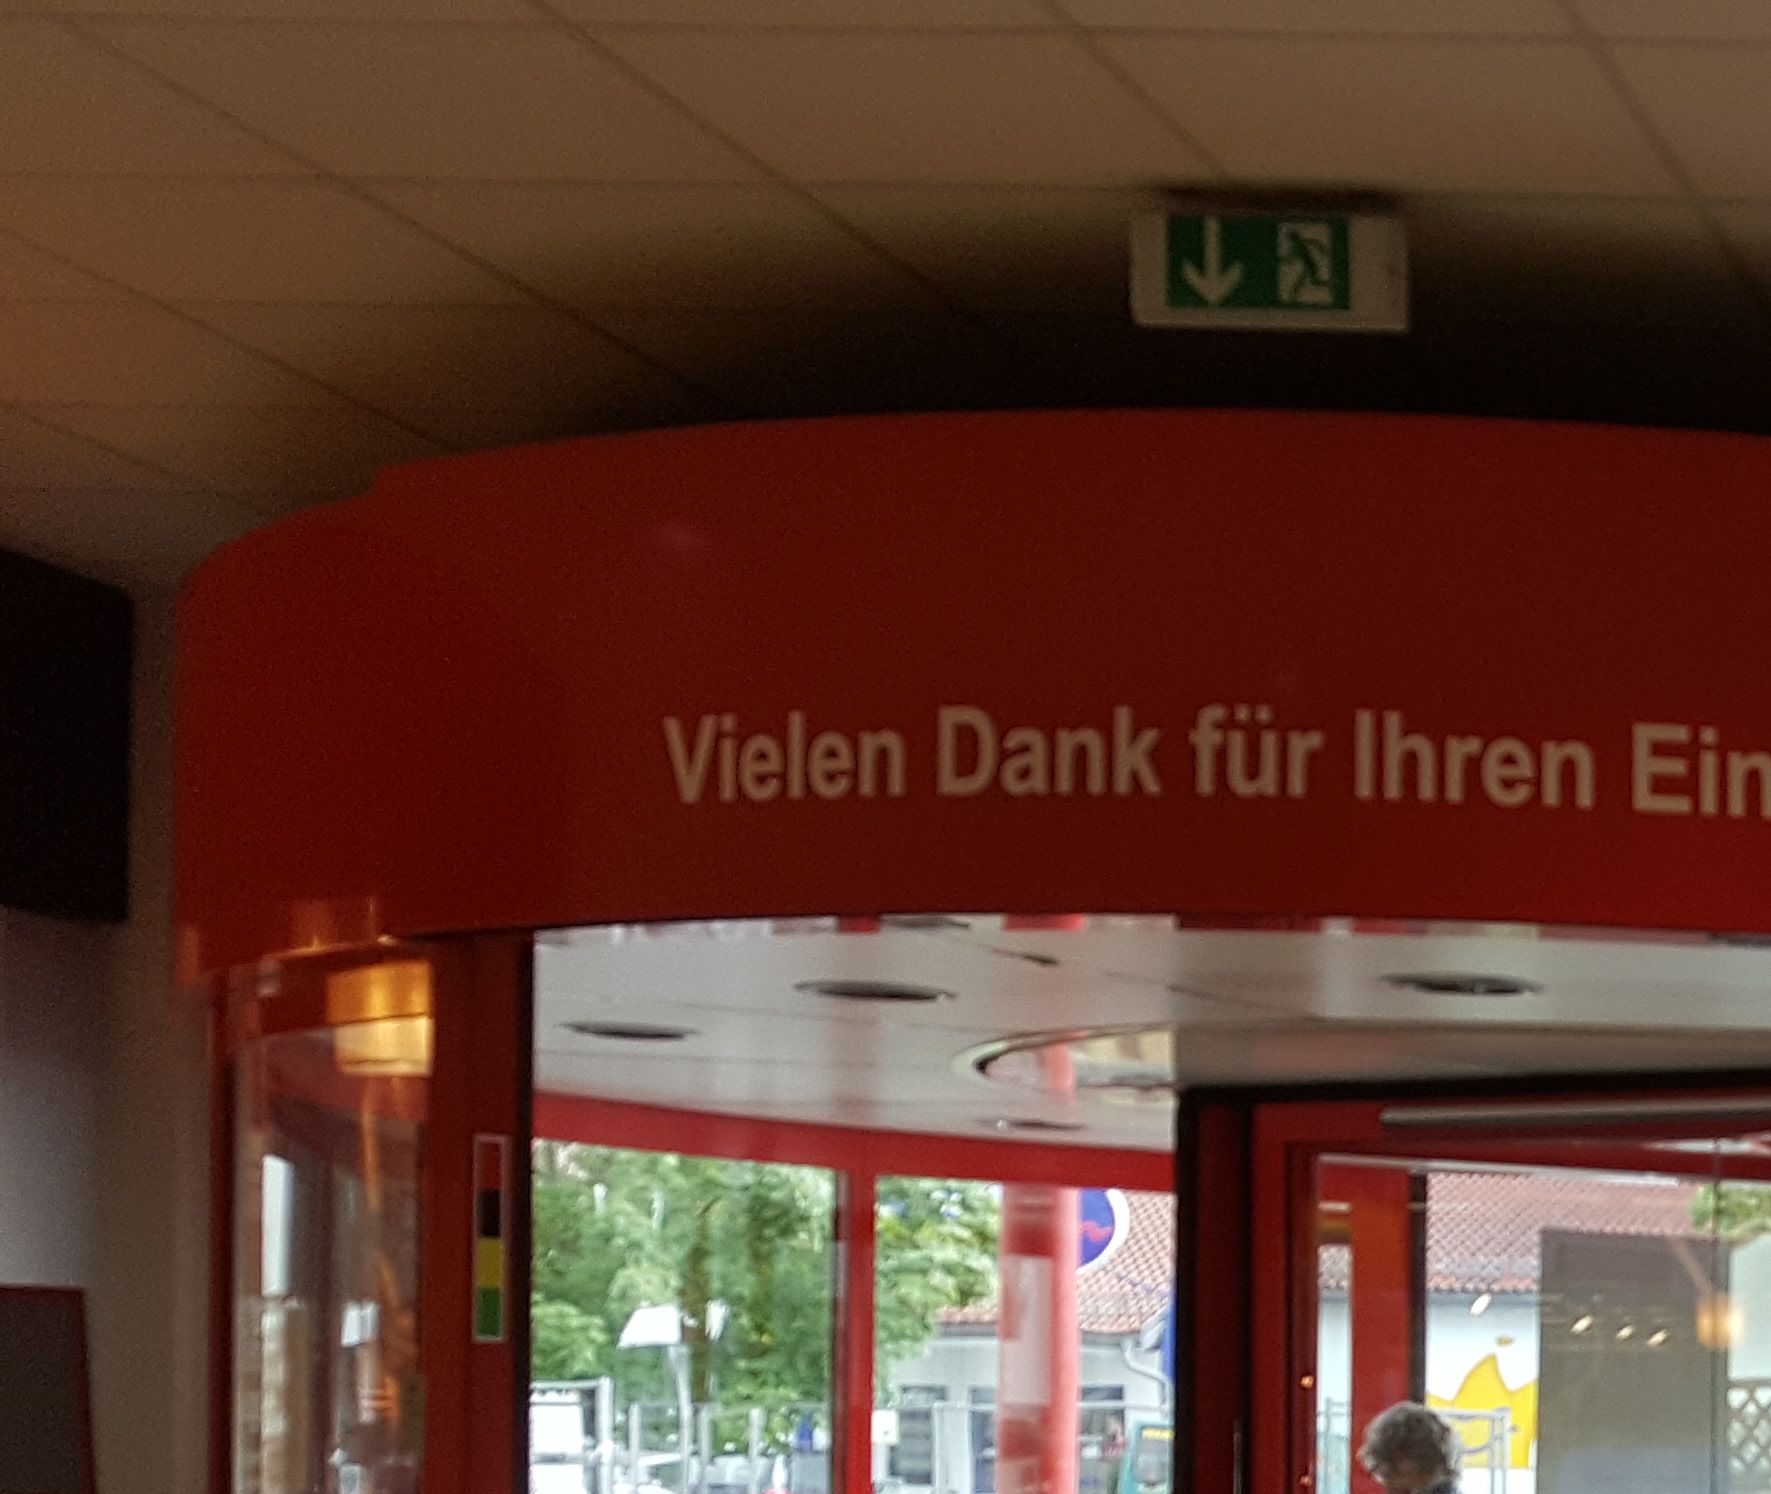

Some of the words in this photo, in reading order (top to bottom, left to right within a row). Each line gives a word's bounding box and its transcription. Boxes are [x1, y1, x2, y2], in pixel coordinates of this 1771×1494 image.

[665, 711, 907, 803] Vielen
[937, 702, 1163, 800] Dank
[1189, 702, 1324, 800] für
[1354, 706, 1600, 810] Ihren
